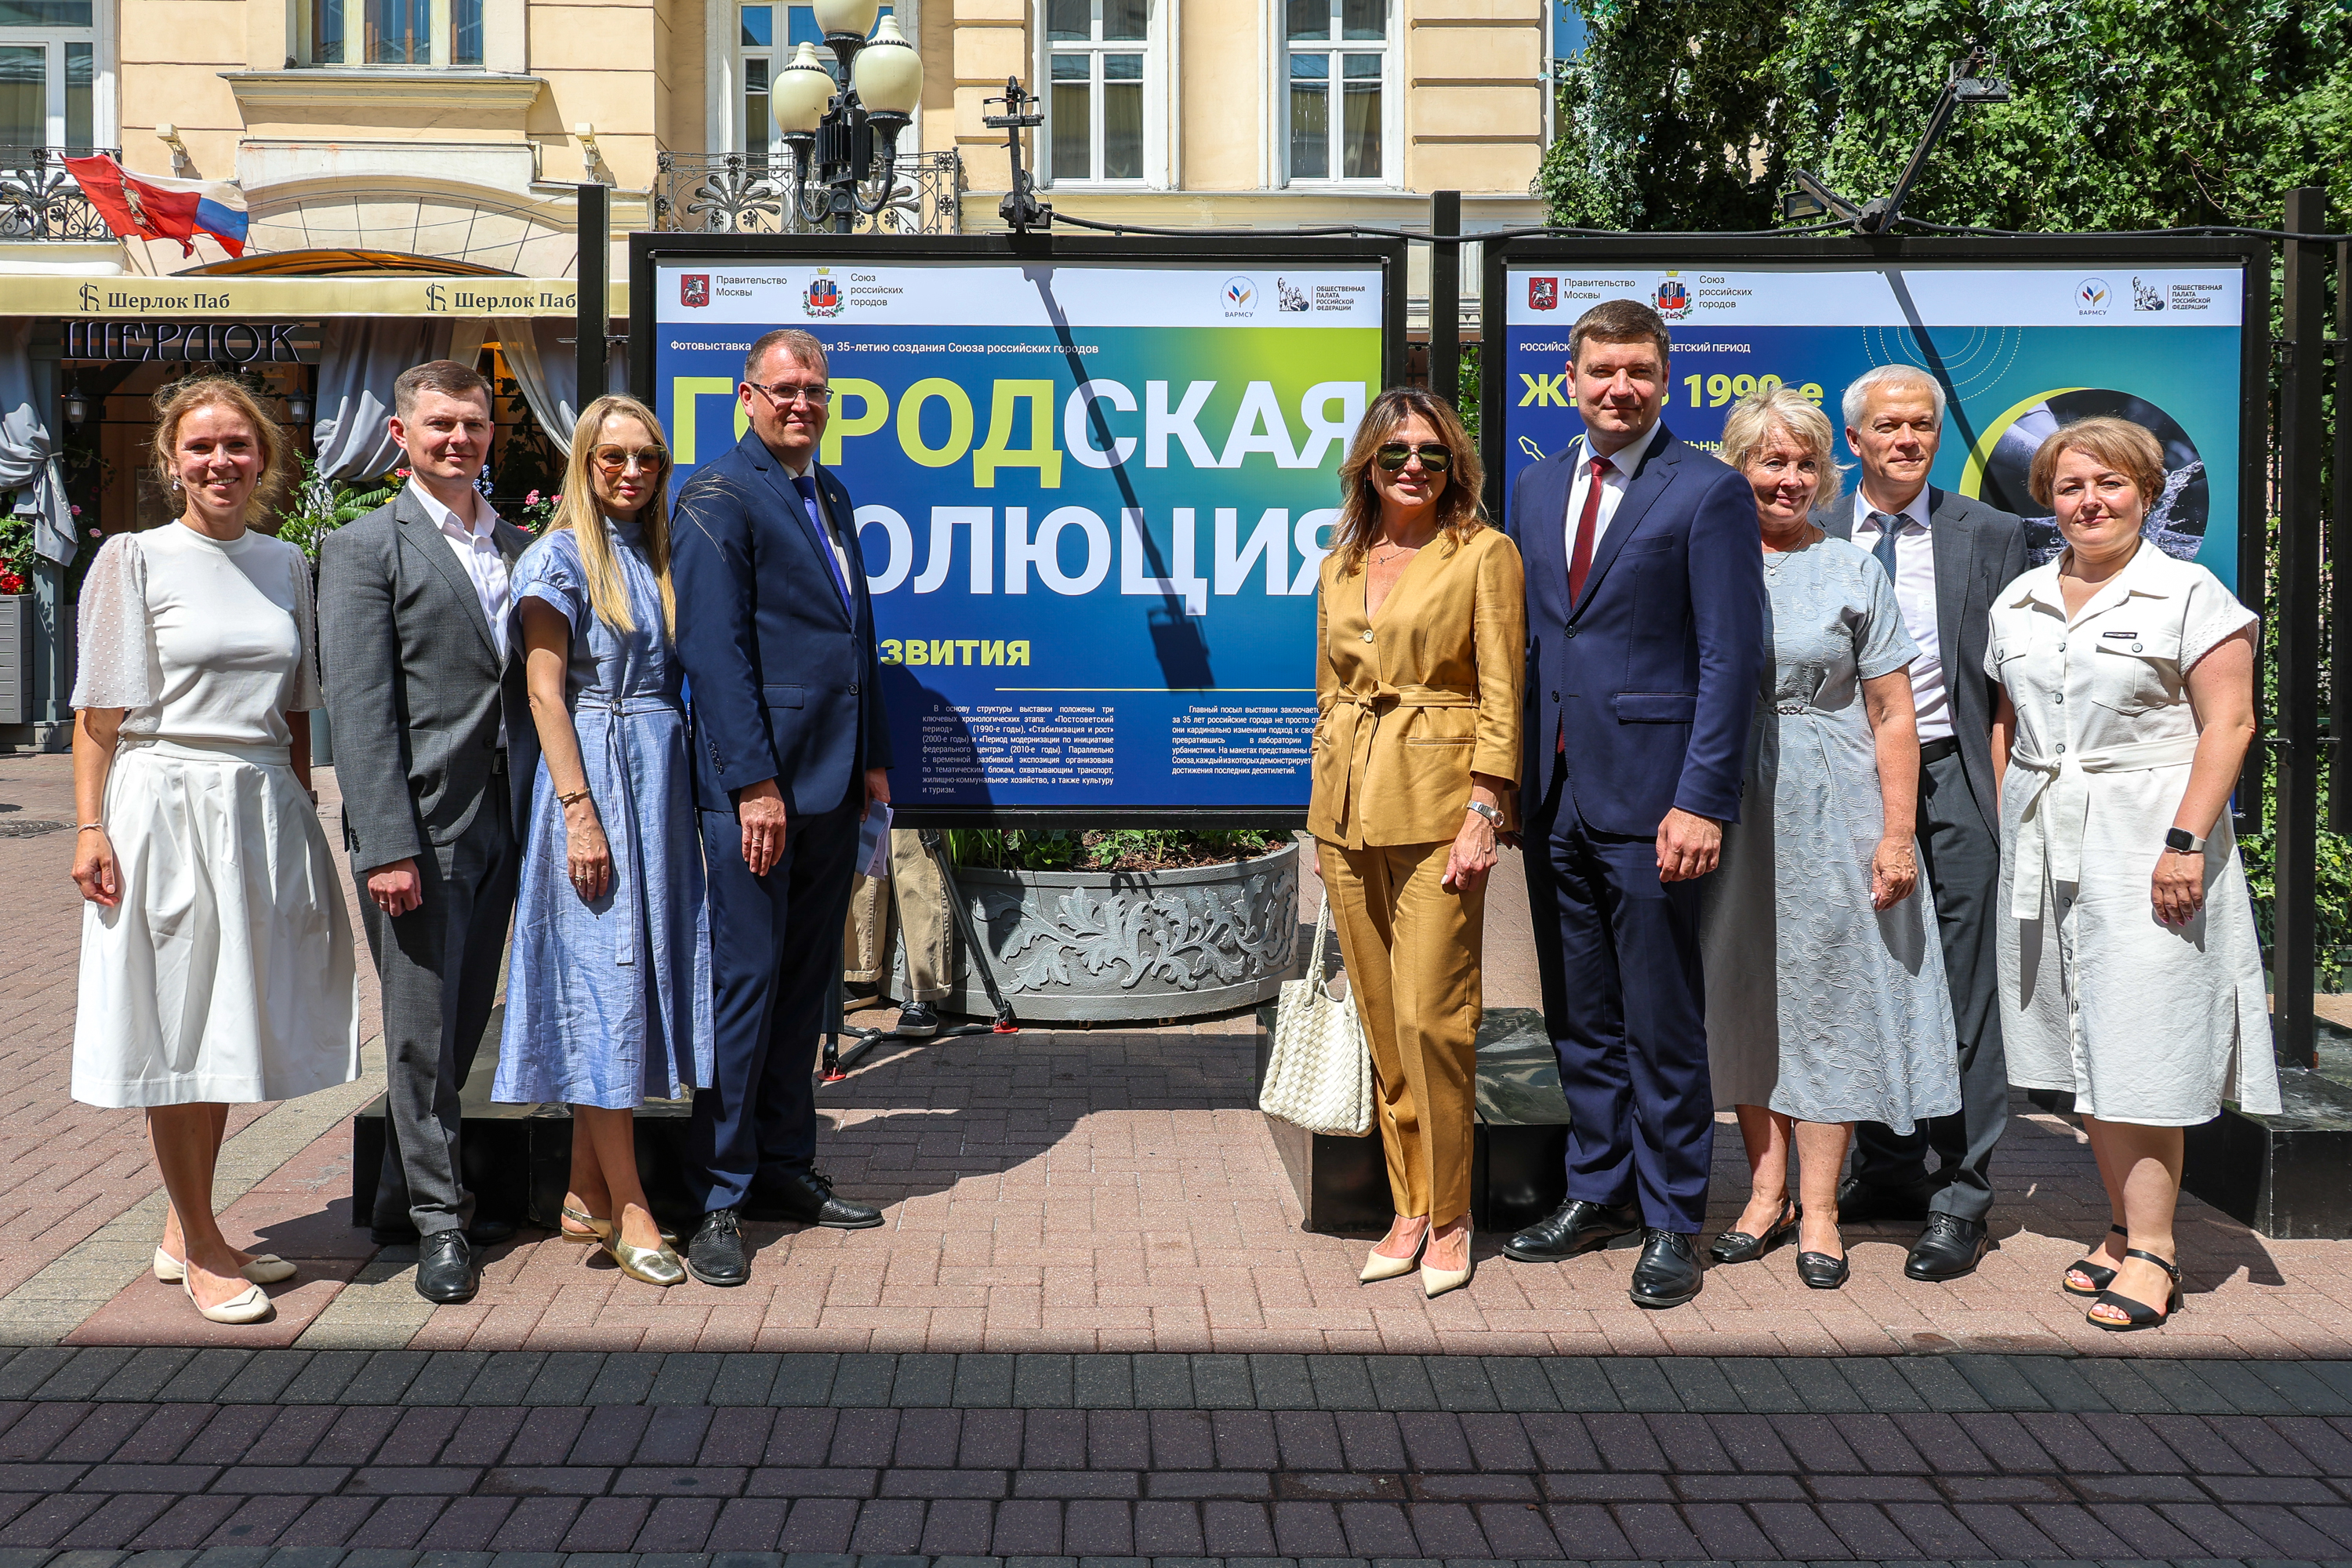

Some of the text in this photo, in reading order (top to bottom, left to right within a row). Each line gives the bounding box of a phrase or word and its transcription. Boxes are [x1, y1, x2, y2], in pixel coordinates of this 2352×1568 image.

[716, 275, 787, 285] Правительство
[851, 273, 876, 282] Союз
[1699, 275, 1725, 284] Союз
[1564, 278, 1635, 288] Правительство
[716, 288, 753, 296] Москвы
[851, 285, 903, 296] российских
[1564, 290, 1600, 299] Москвы
[1699, 286, 1752, 298] российских
[107, 292, 188, 312] Шерлок
[194, 292, 230, 309] Паб
[454, 292, 535, 311] Шерлок
[539, 292, 576, 308] Паб
[851, 298, 887, 307] городов
[1699, 299, 1737, 310] городов
[62, 321, 301, 362] ШЕРЛОК
[670, 340, 751, 350] Фотовыставка
[837, 340, 889, 352] 35-летию
[892, 342, 946, 353] создания
[947, 342, 985, 352] Союза
[986, 342, 1051, 354] российских
[1053, 343, 1098, 354] городов
[1520, 341, 1570, 351] РОССИЙСК
[1712, 343, 1751, 354] ПЕРИОД
[673, 376, 1367, 488] ГРОДСКАЯ
[1207, 716, 1247, 724] российские
[973, 725, 1000, 734] (1990-е
[1004, 725, 1025, 734] годы),
[1029, 725, 1084, 734] «Стабилизация
[923, 735, 947, 744] (2000-е
[950, 735, 969, 744] годы)
[979, 735, 1007, 744] «Период
[1258, 736, 1301, 745] лаборатории
[1011, 746, 1035, 754] (2010-е
[1042, 746, 1062, 754] годы).
[1172, 746, 1216, 755] урбанистики.
